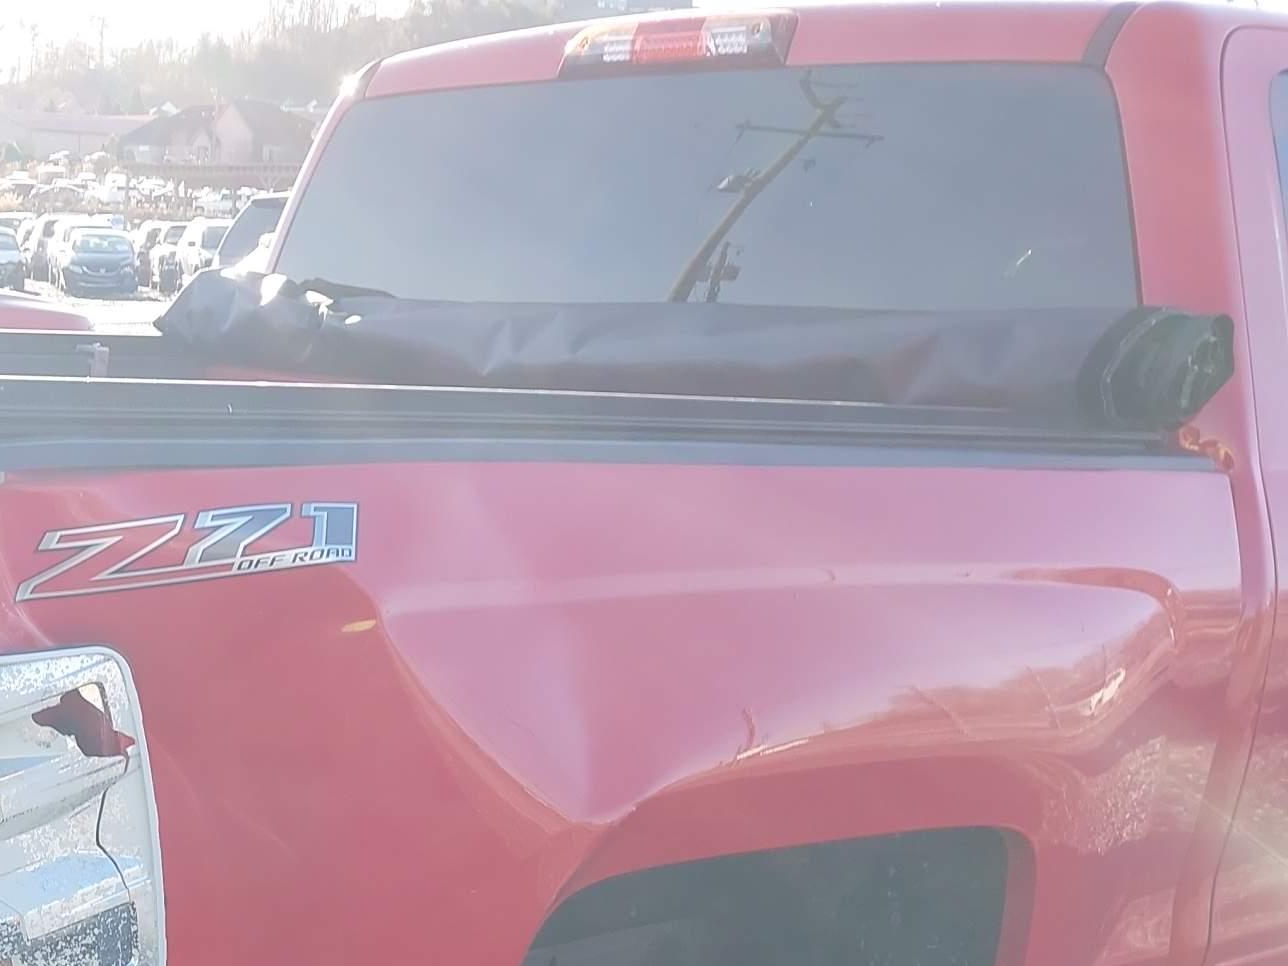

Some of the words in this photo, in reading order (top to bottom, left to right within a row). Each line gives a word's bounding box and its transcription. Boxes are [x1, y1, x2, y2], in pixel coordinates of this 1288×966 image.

[16, 502, 358, 601] Z71
[237, 554, 286, 571] OFF
[291, 547, 353, 564] ROAD
